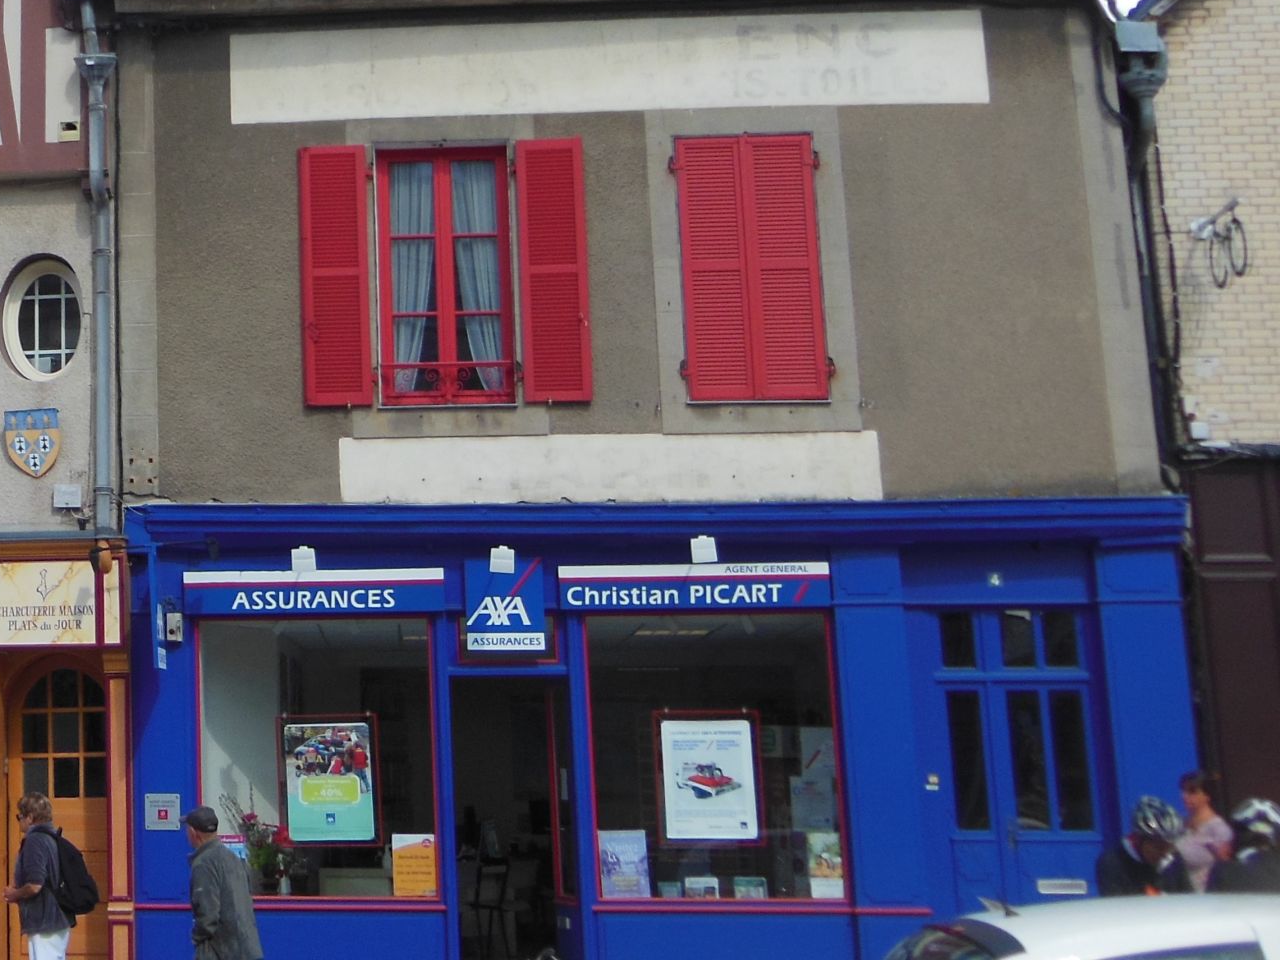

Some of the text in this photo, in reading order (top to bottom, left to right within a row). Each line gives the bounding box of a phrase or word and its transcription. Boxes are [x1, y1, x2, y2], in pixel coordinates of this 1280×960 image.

[724, 564, 809, 574] AGENT GENERAL
[232, 589, 395, 610] ASSURANCES
[566, 583, 783, 606] Christian PICART
[59, 604, 94, 615] MAISON
[466, 596, 532, 626] AXA
[8, 619, 82, 631] PLATS du JOUR
[472, 637, 542, 646] ASSURANCES
